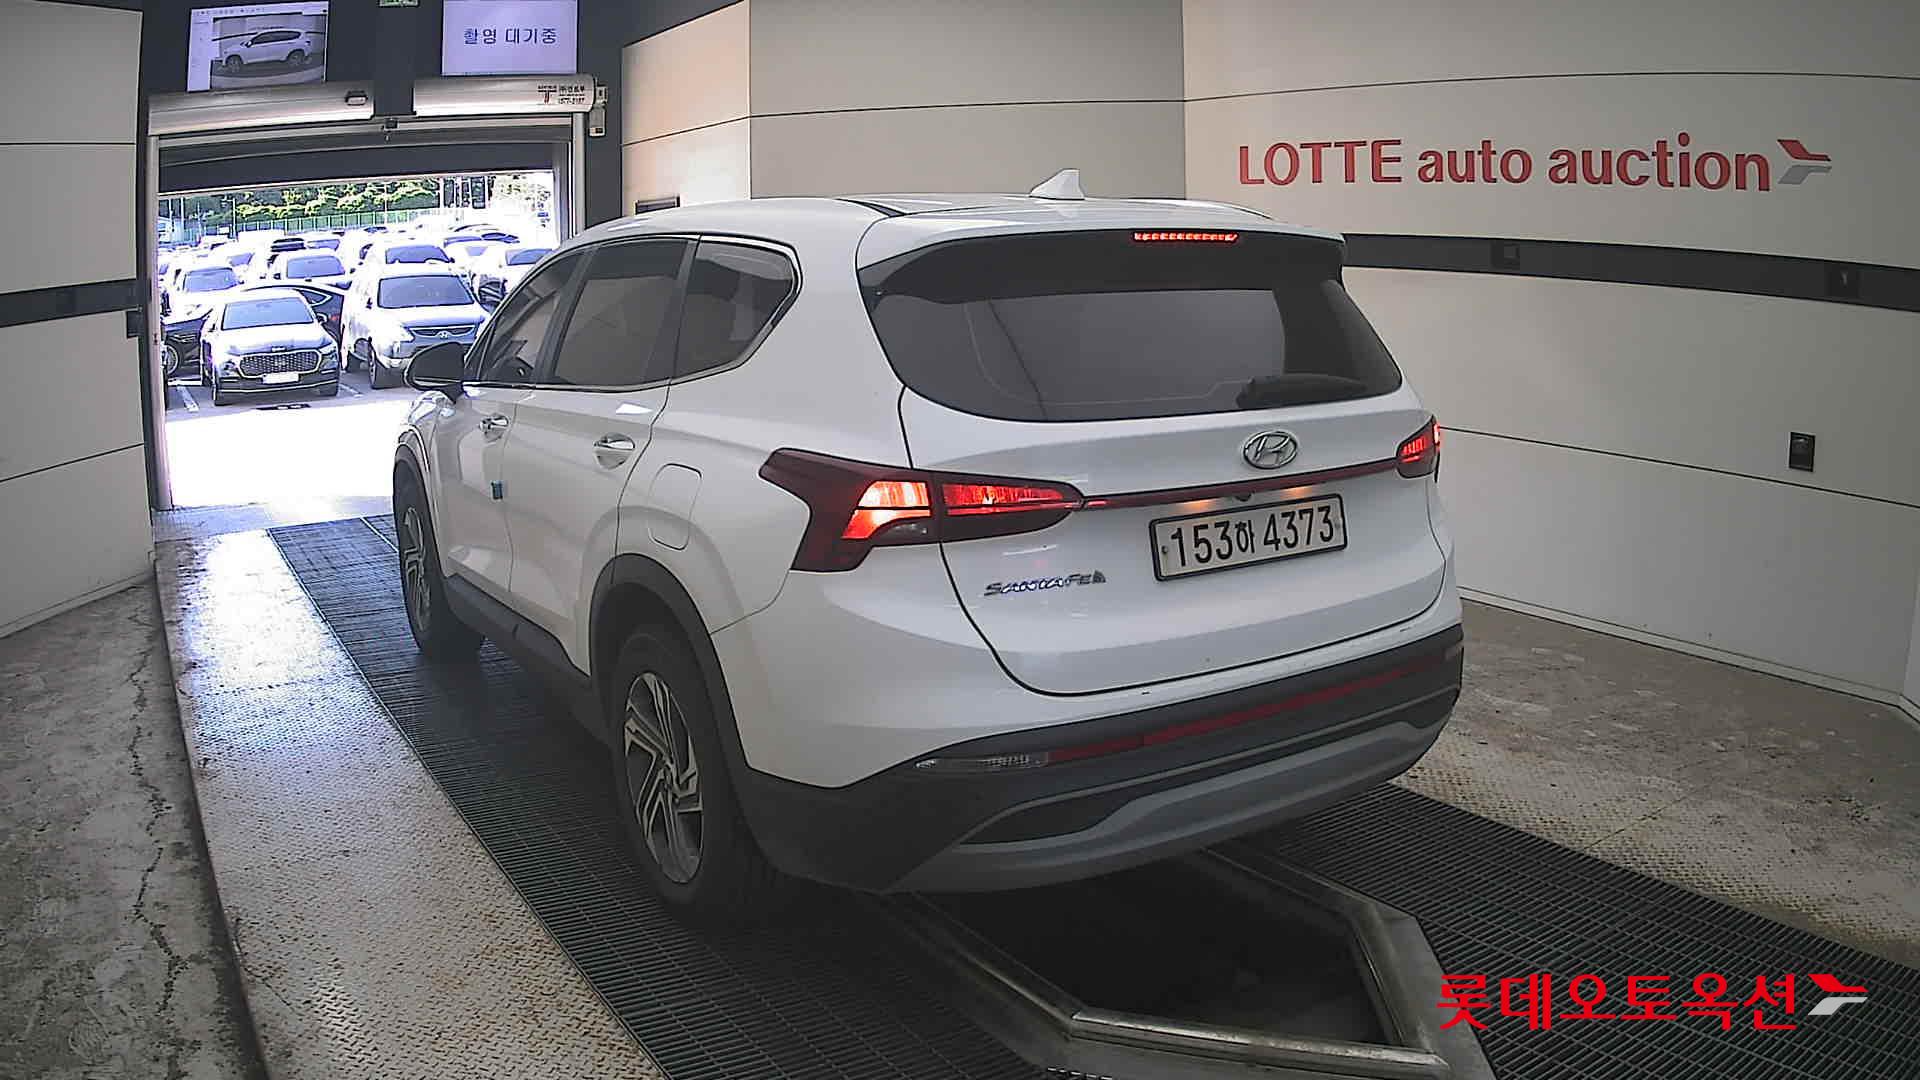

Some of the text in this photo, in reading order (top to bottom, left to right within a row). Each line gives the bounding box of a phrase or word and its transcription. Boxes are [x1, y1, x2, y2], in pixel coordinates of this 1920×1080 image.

[504, 28, 557, 45] 대기중
[1239, 132, 1771, 190] LOTTE auto auction
[1171, 505, 1334, 566] 153하 4373
